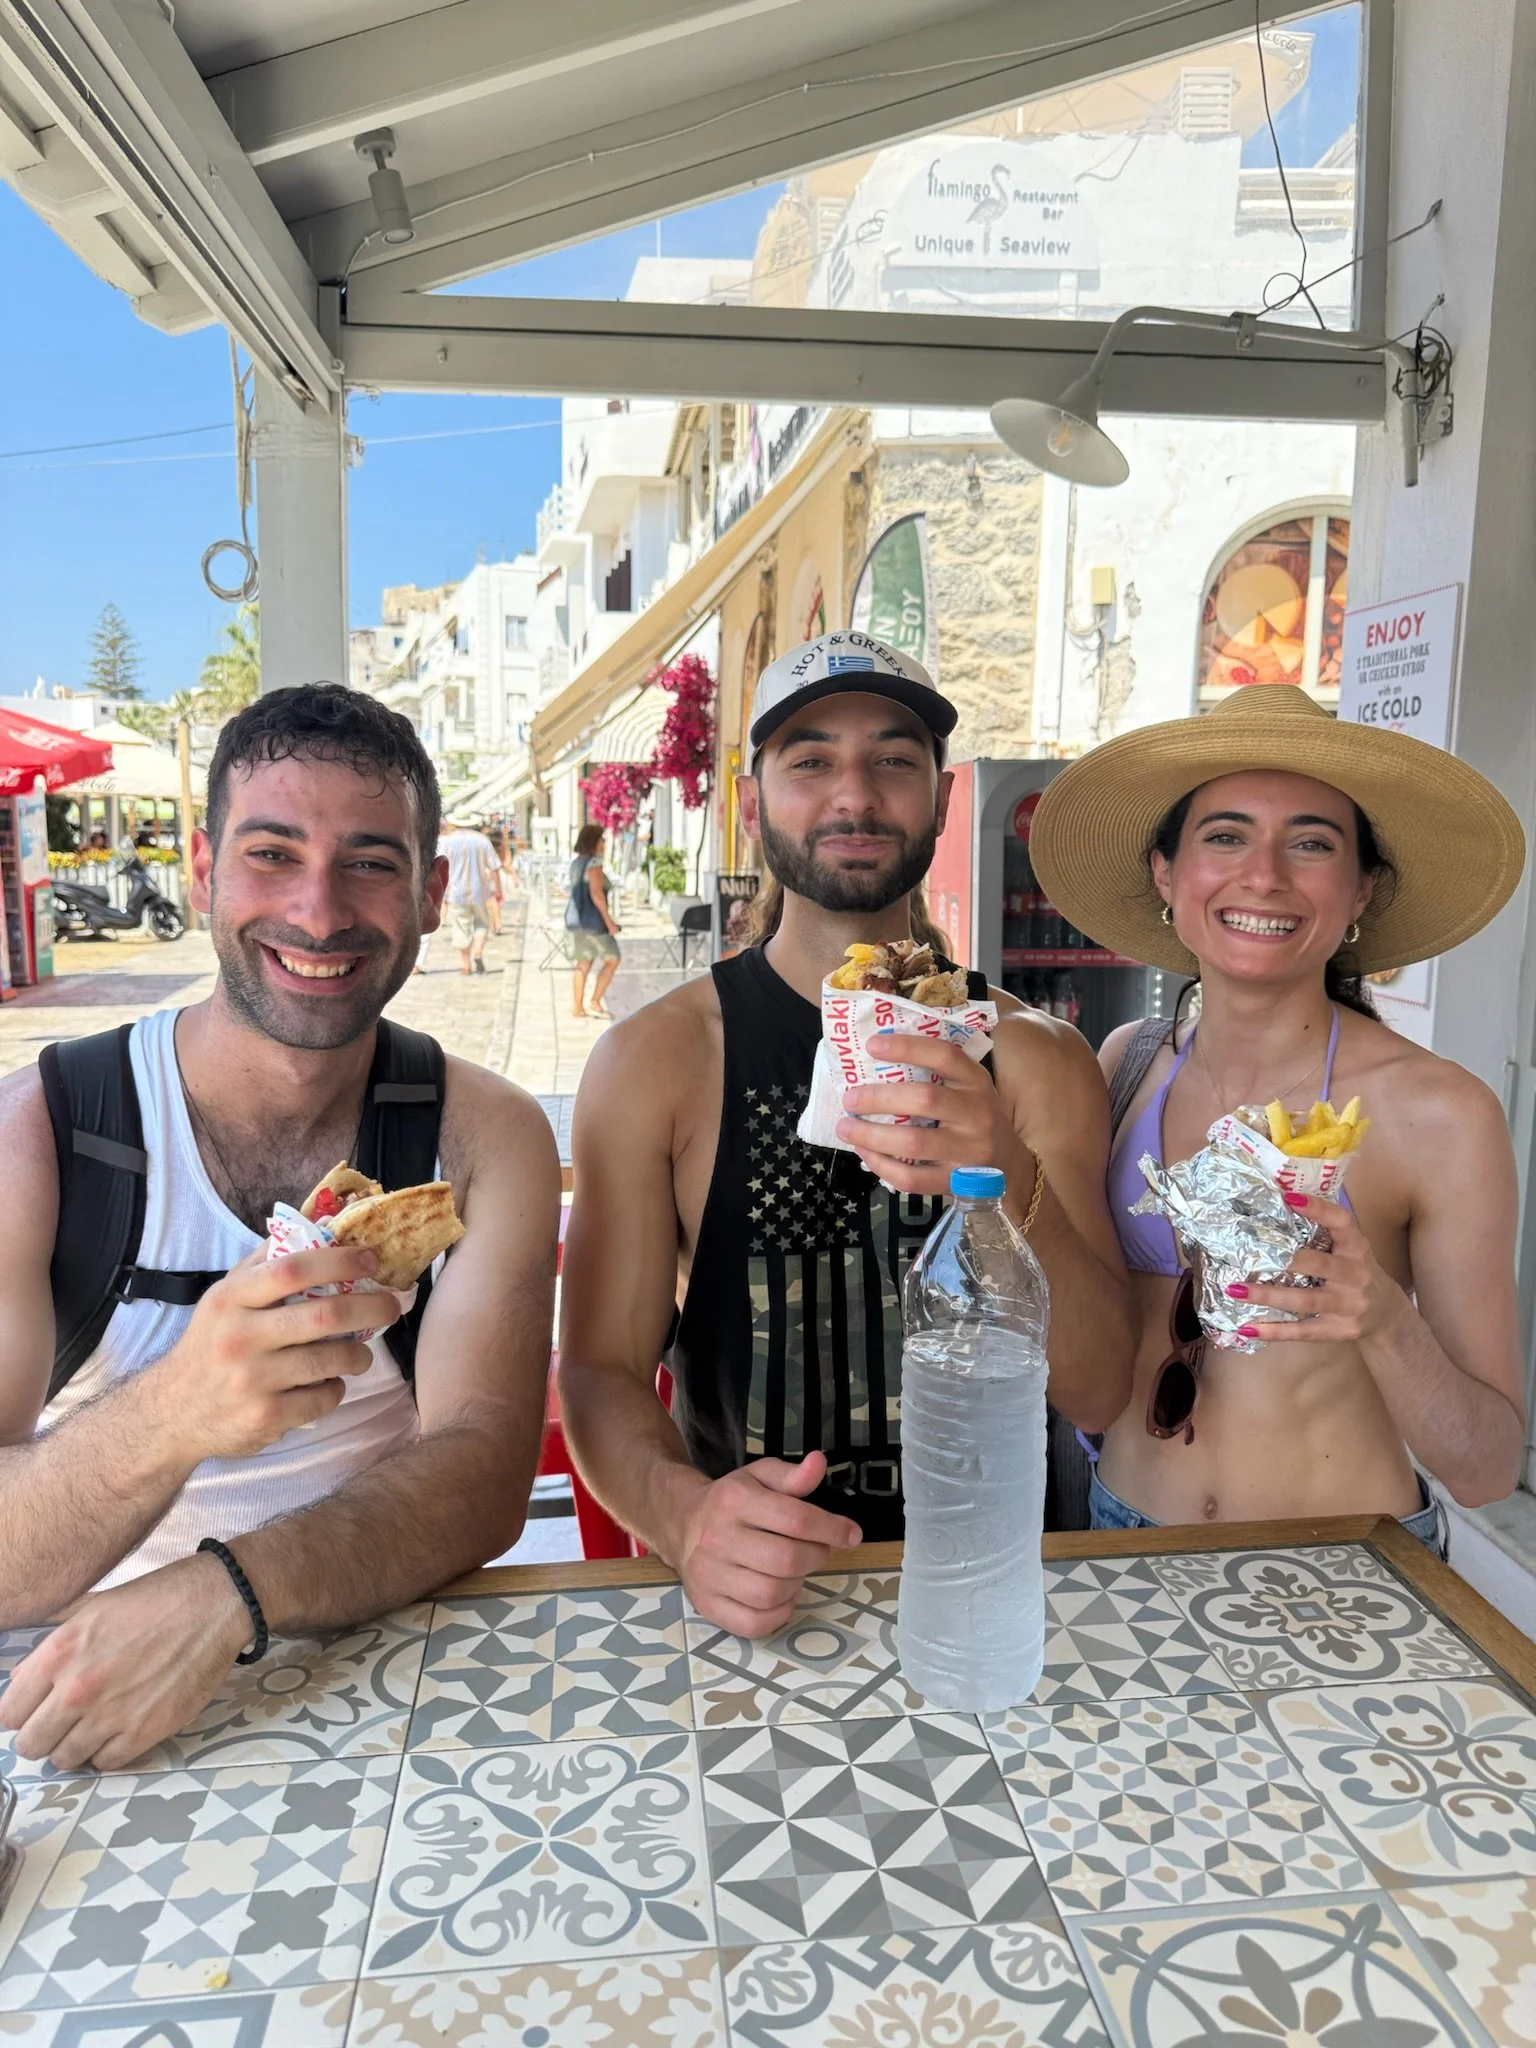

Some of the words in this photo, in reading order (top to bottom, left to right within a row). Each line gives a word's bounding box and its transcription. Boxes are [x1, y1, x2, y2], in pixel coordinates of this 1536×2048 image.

[1013, 189, 1079, 205] Restaurant
[1042, 207, 1064, 221] Bar
[914, 235, 974, 258] Unique
[1000, 236, 1071, 255] Seaview
[1366, 610, 1426, 649] ENJOY
[791, 642, 824, 677] HOT
[829, 635, 845, 646] &
[849, 634, 908, 677] GREEK
[1362, 648, 1409, 669] TRADITIONAL
[1409, 642, 1430, 660] PORK
[1358, 671, 1368, 685] OR
[1368, 664, 1400, 683] CHICKEN
[1400, 660, 1426, 678] GYROS
[1377, 684, 1391, 697] with
[1357, 701, 1378, 723] ICE
[1381, 696, 1422, 720] COLD
